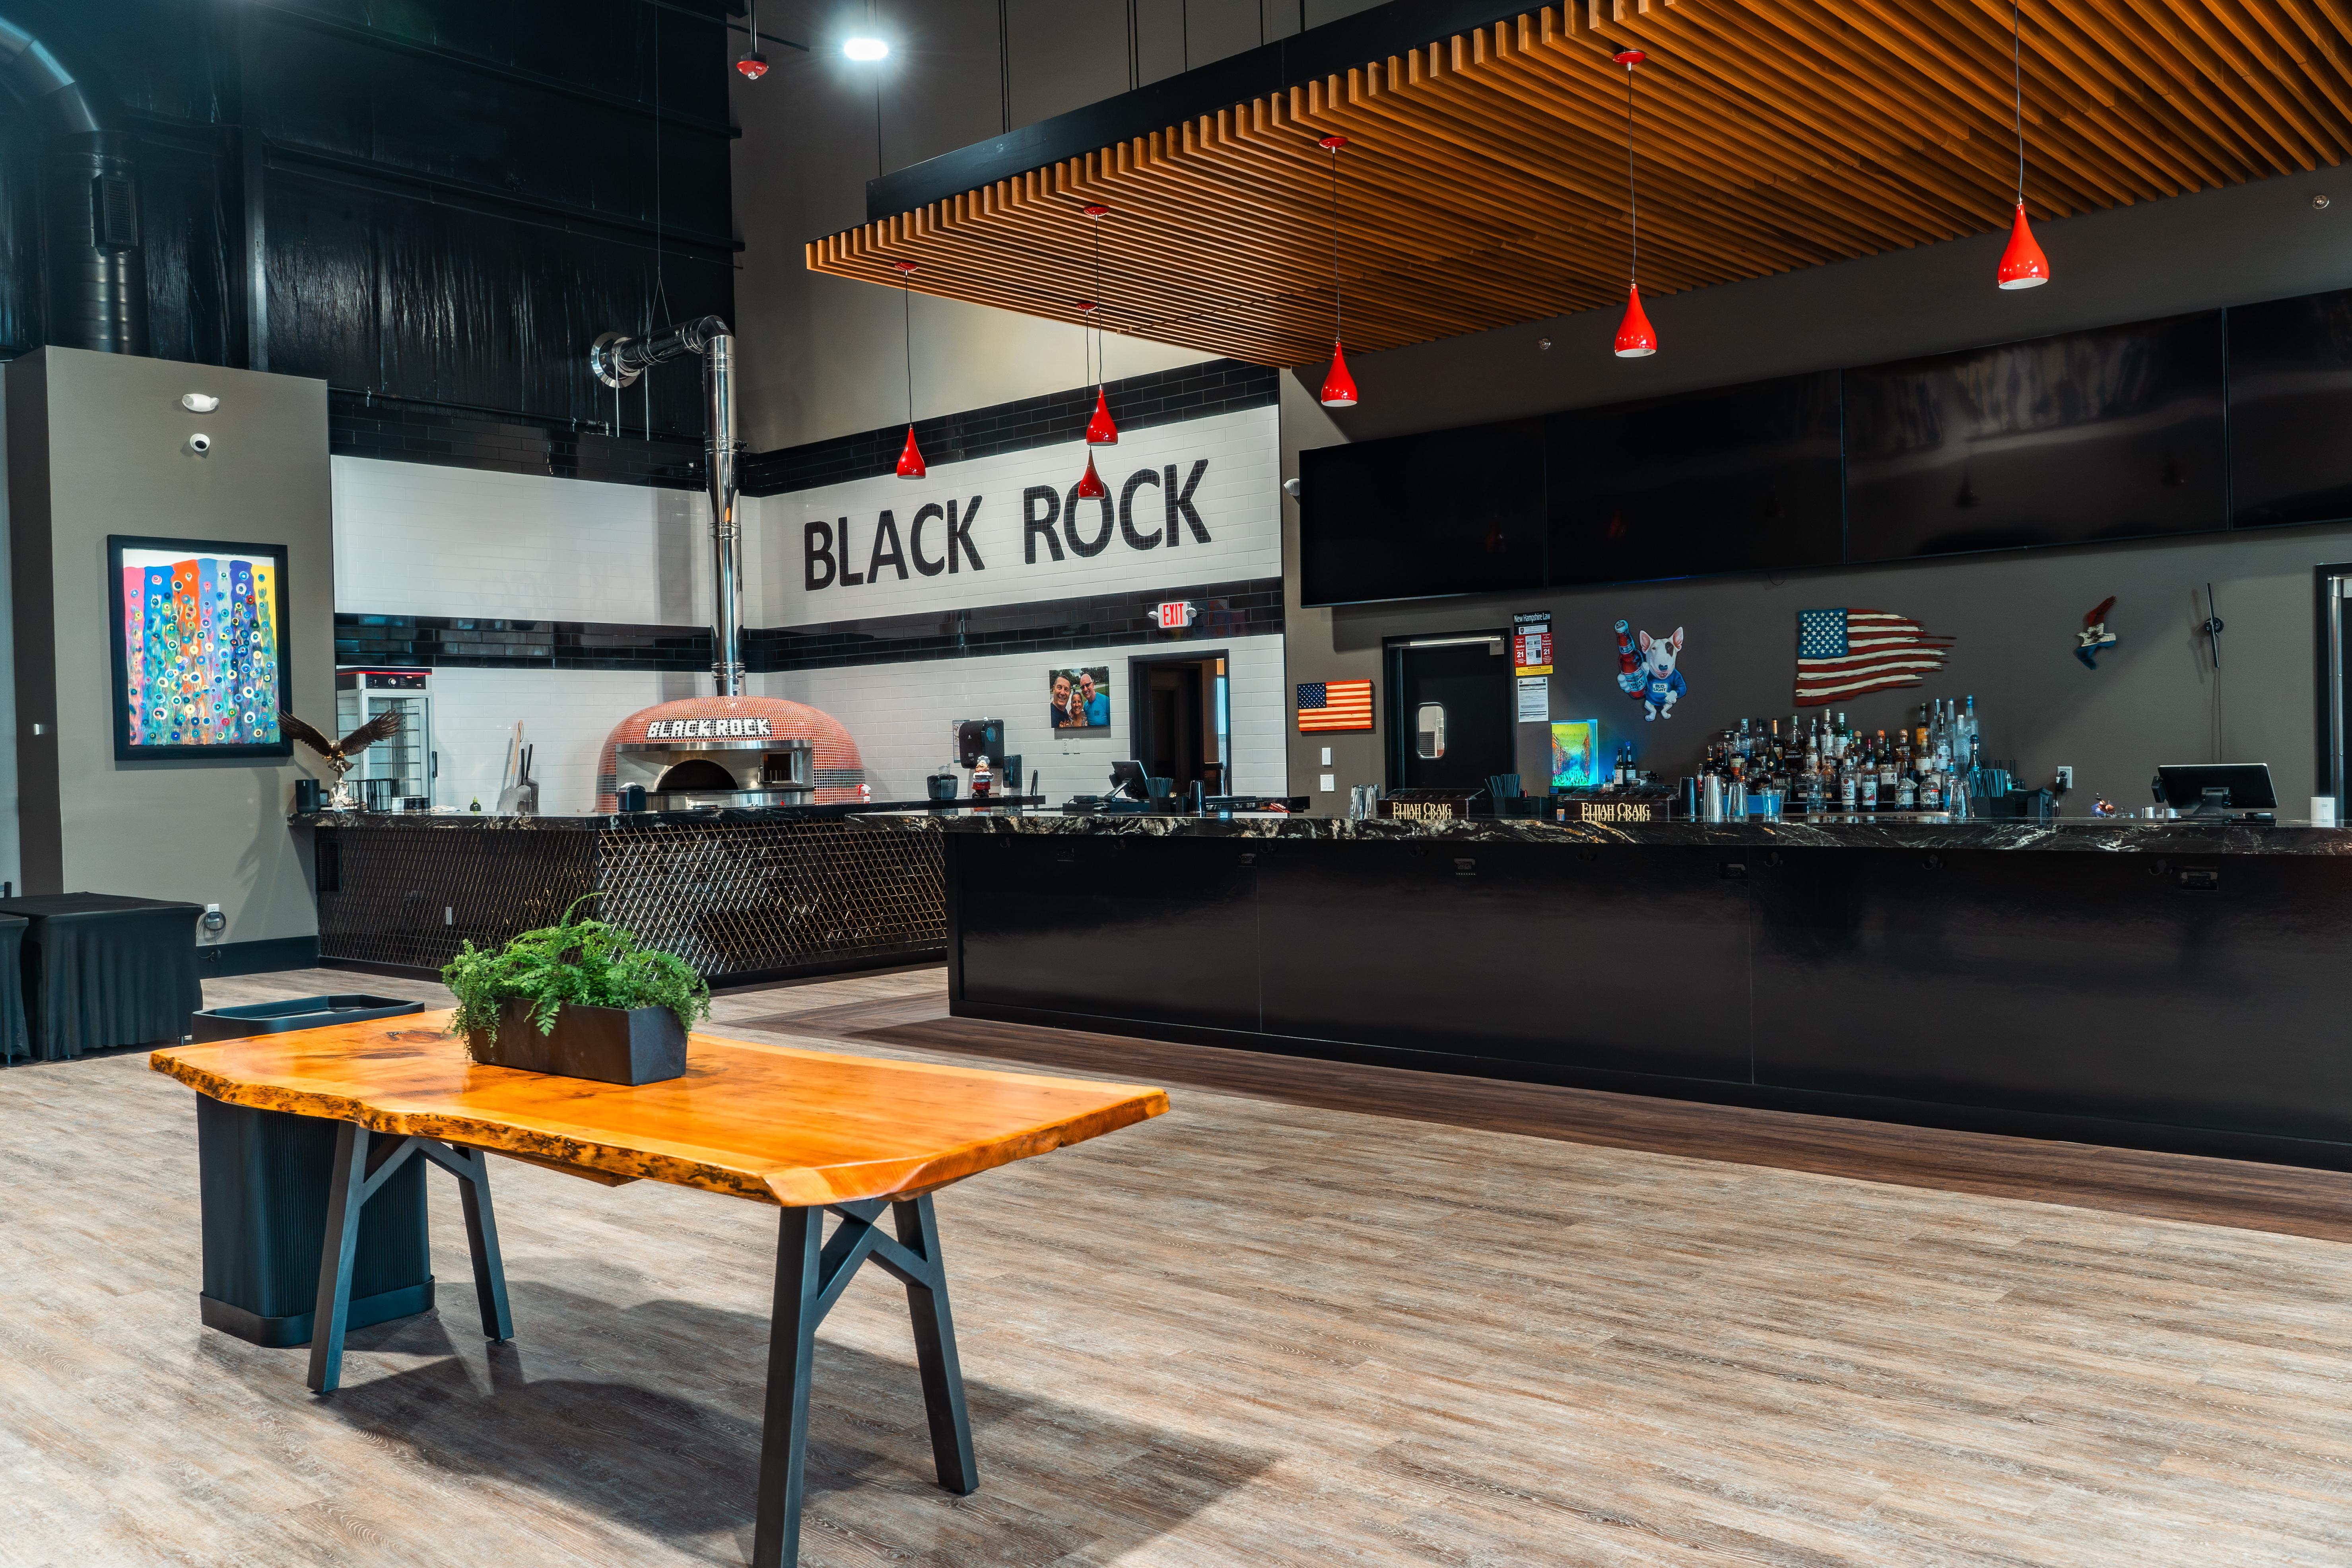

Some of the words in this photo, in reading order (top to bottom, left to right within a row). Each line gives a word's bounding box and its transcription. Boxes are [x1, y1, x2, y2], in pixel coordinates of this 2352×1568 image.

[804, 495, 985, 591] BLACK
[1023, 459, 1212, 564] ROCK
[1163, 603, 1183, 626] EXIT
[1523, 613, 1542, 623] Hampshire
[647, 719, 712, 737] BLACK
[715, 719, 773, 735] ROCK
[1393, 802, 1422, 814] ELIJAH
[1423, 802, 1452, 815] CRAIG
[1581, 802, 1615, 816] ELIJAH
[1617, 802, 1650, 816] CRAIG
